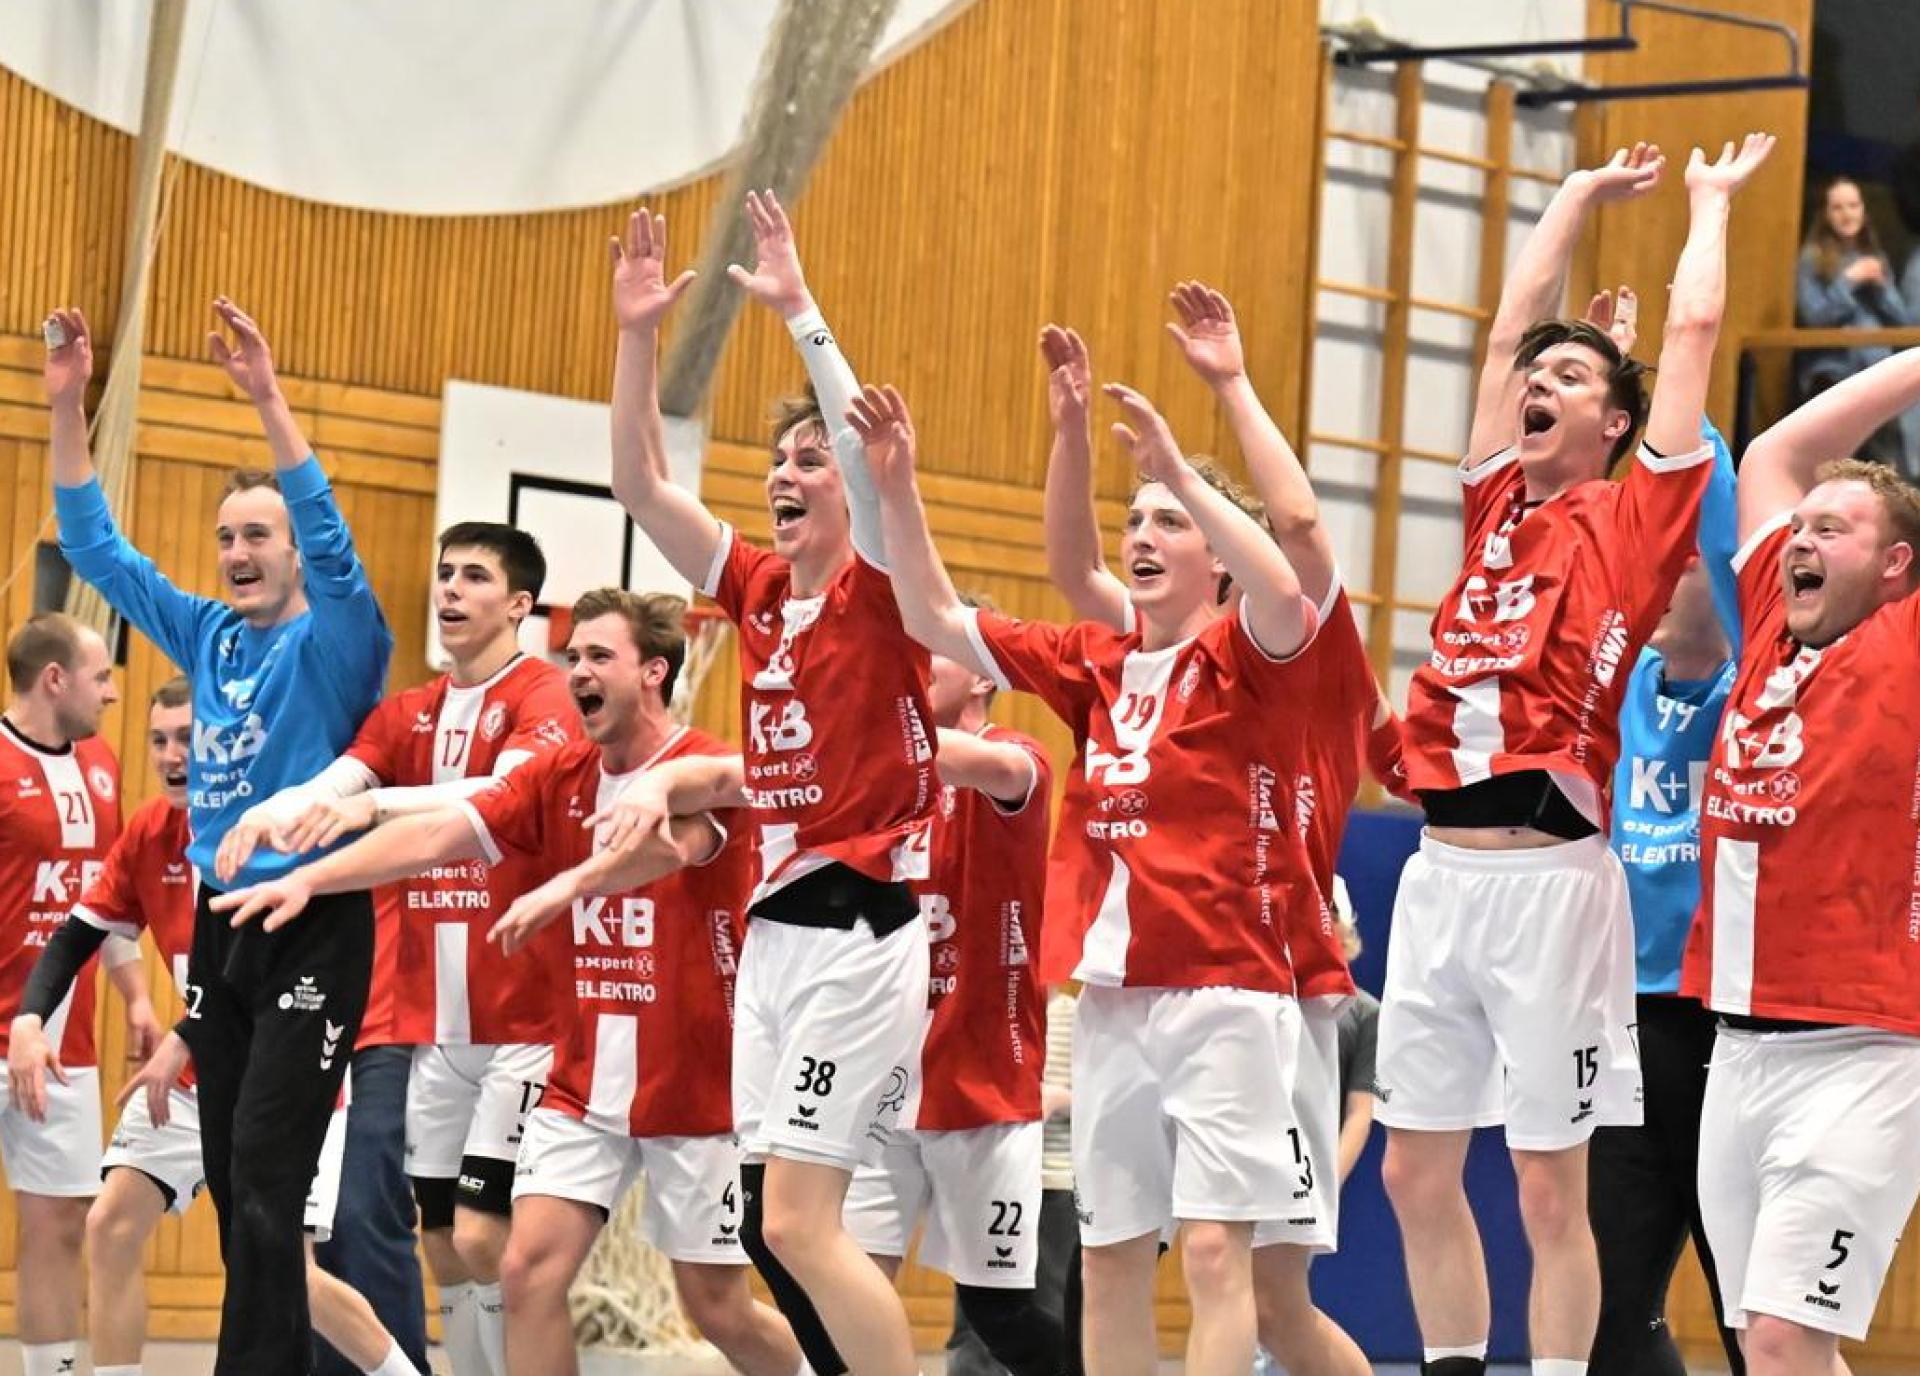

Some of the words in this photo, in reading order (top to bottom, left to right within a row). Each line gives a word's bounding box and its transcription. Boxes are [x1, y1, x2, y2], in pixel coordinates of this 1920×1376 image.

[750, 699, 813, 754] K+B
[1121, 693, 1156, 731] 19
[1656, 695, 1697, 732] 99
[441, 729, 468, 767] 17
[1722, 710, 1804, 768] K+B
[60, 792, 88, 825] 21
[742, 785, 822, 809] ELEKTRO
[409, 866, 468, 880] xpert
[407, 890, 491, 909] ELEKTRO
[572, 896, 655, 947] K+B
[575, 956, 633, 970] expert
[575, 980, 656, 1002] ELEKTRO
[1008, 970, 1020, 1019] Hannes
[795, 1056, 836, 1097] 38
[1573, 1046, 1598, 1088] 15
[521, 1080, 545, 1113] 17
[722, 1181, 735, 1214] 4
[988, 1201, 1022, 1236] 22
[1826, 1230, 1854, 1269] 5
[1805, 1295, 1840, 1312] erima
